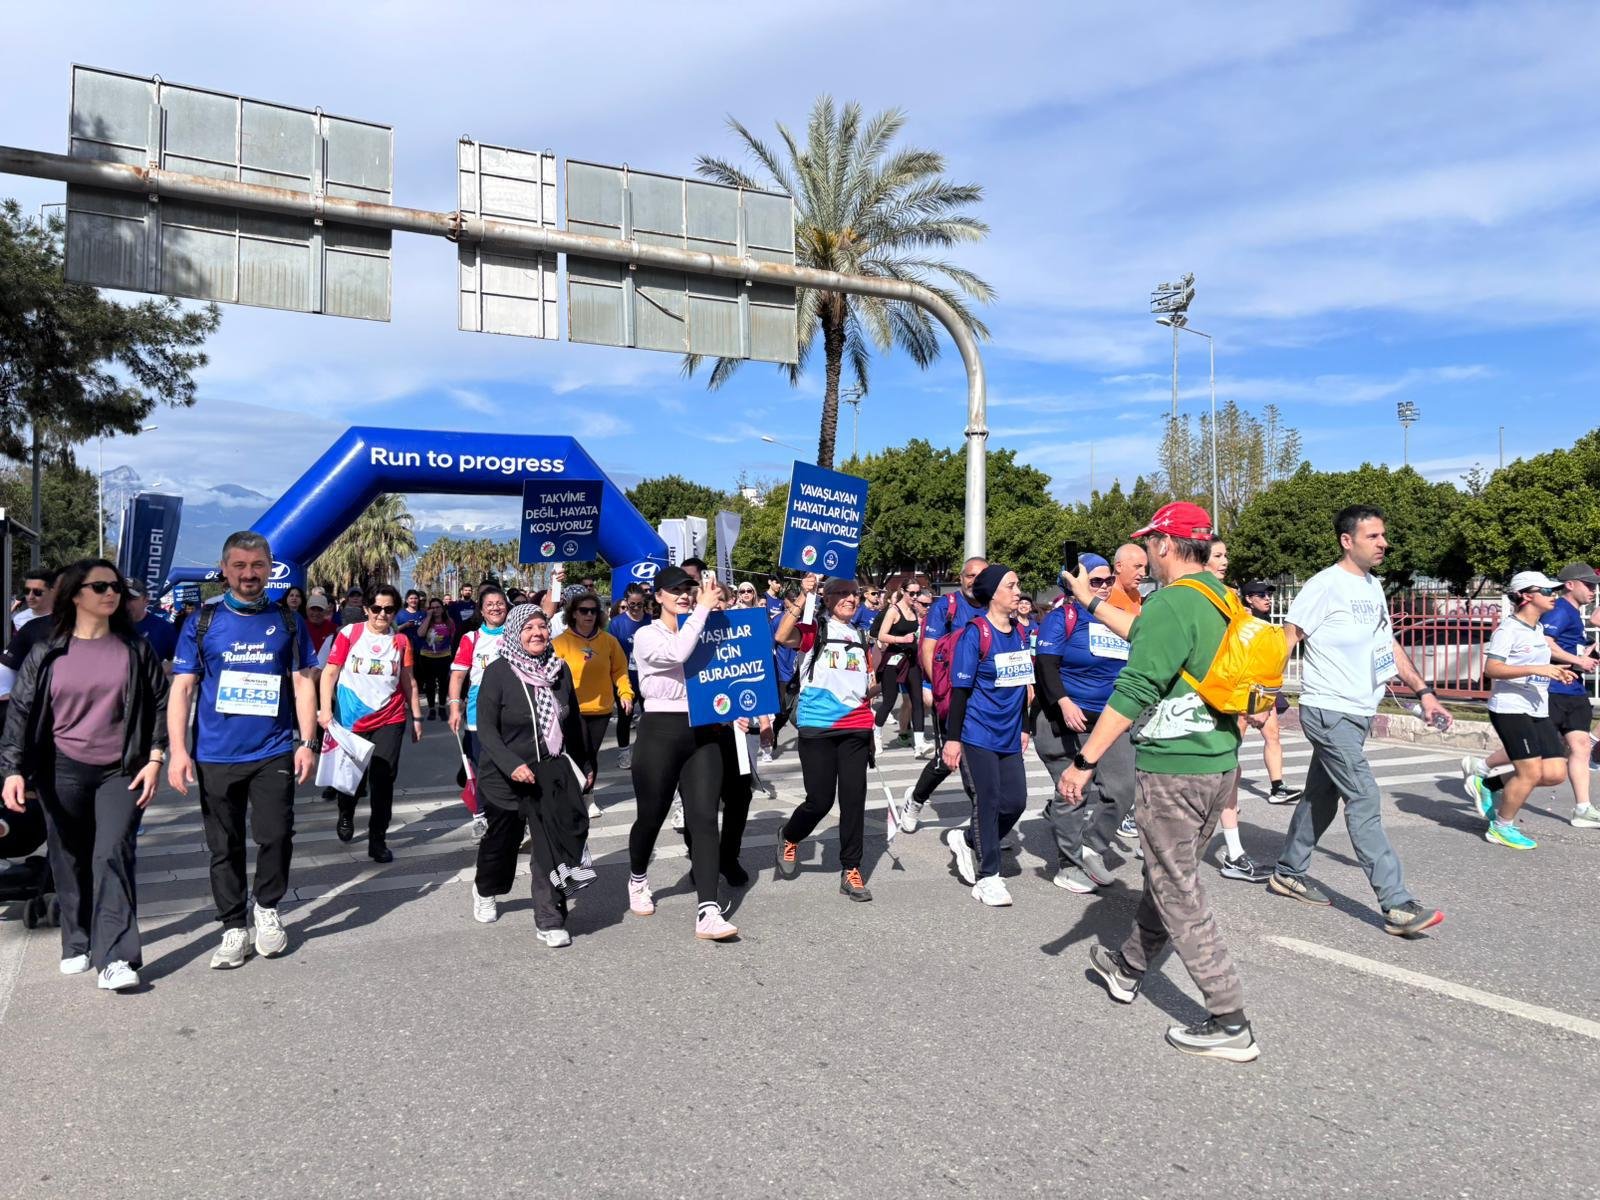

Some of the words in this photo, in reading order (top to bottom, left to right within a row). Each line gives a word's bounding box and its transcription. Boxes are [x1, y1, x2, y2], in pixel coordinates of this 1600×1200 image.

[370, 447, 421, 467] Run
[427, 450, 453, 468] to
[459, 455, 565, 475] progress
[539, 490, 586, 504] TAKVİME
[800, 482, 858, 506] YAVAŞLAYAN
[525, 505, 559, 520] DEĞİL,
[560, 505, 599, 518] HAYATA
[793, 499, 840, 519] HAYATLAR
[841, 506, 860, 523] İÇİN
[529, 519, 593, 534] KOŞUYORUZ
[790, 516, 858, 539] HIZLANIYORUZ
[147, 528, 164, 601] HYUNDAI
[1351, 603, 1375, 614] RUN
[699, 624, 752, 645] YAŞLILAR
[716, 643, 741, 663] İÇİN
[698, 659, 765, 684] BURADAYIZ
[999, 663, 1032, 675] 10845
[222, 687, 276, 701] 11549
